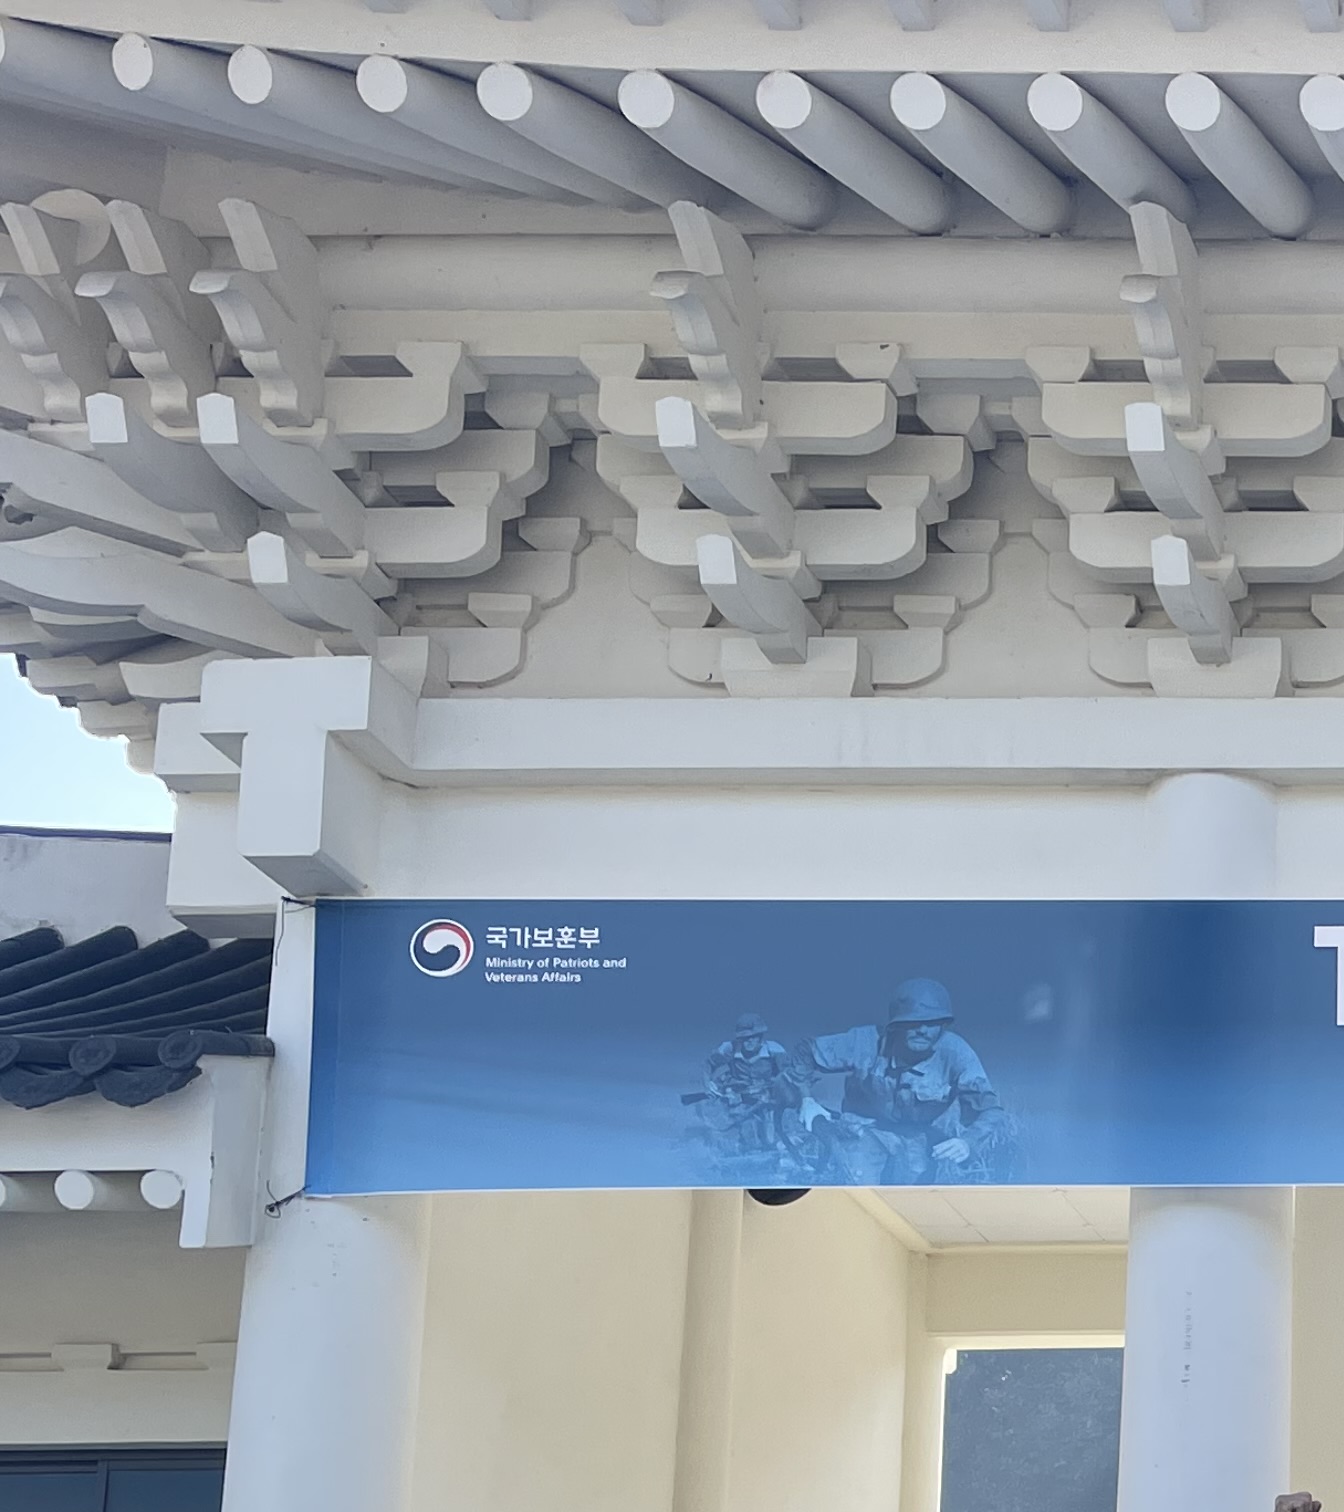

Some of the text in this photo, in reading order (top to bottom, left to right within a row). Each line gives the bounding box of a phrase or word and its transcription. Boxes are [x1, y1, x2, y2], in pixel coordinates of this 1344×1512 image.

[486, 926, 600, 949] 국가보훈부
[485, 957, 627, 970] Ministry of Patriots and
[485, 971, 581, 983] Veterans Affairs
